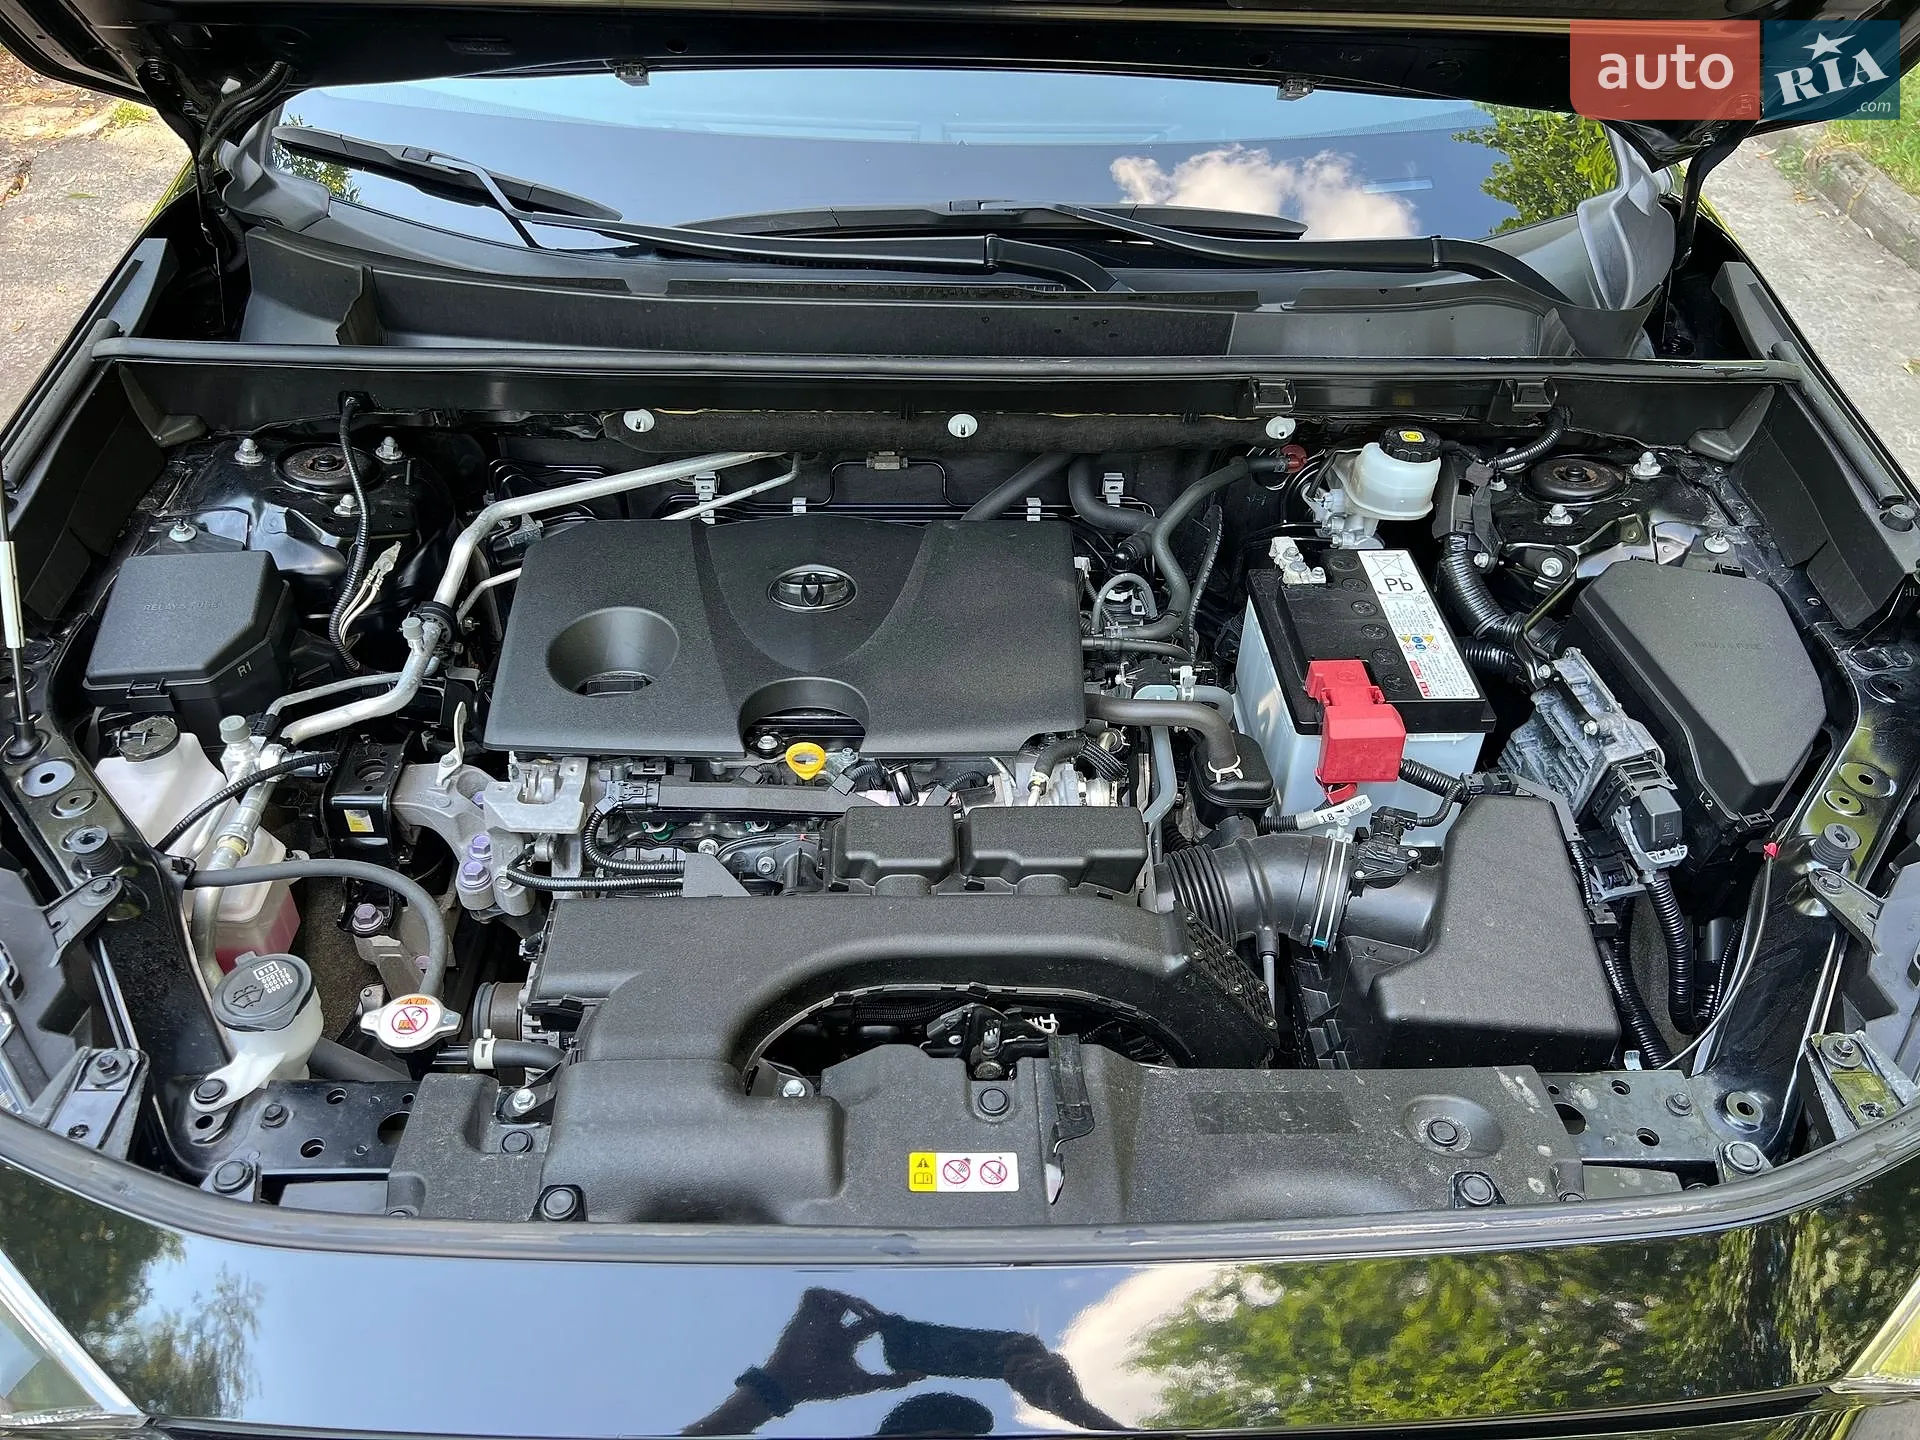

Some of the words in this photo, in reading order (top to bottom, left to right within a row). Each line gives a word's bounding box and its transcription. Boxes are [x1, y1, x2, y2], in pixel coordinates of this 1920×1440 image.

[1384, 578, 1414, 592] Pb
[237, 661, 252, 678] R1
[1698, 790, 1713, 811] L2
[1320, 812, 1335, 824] 18
